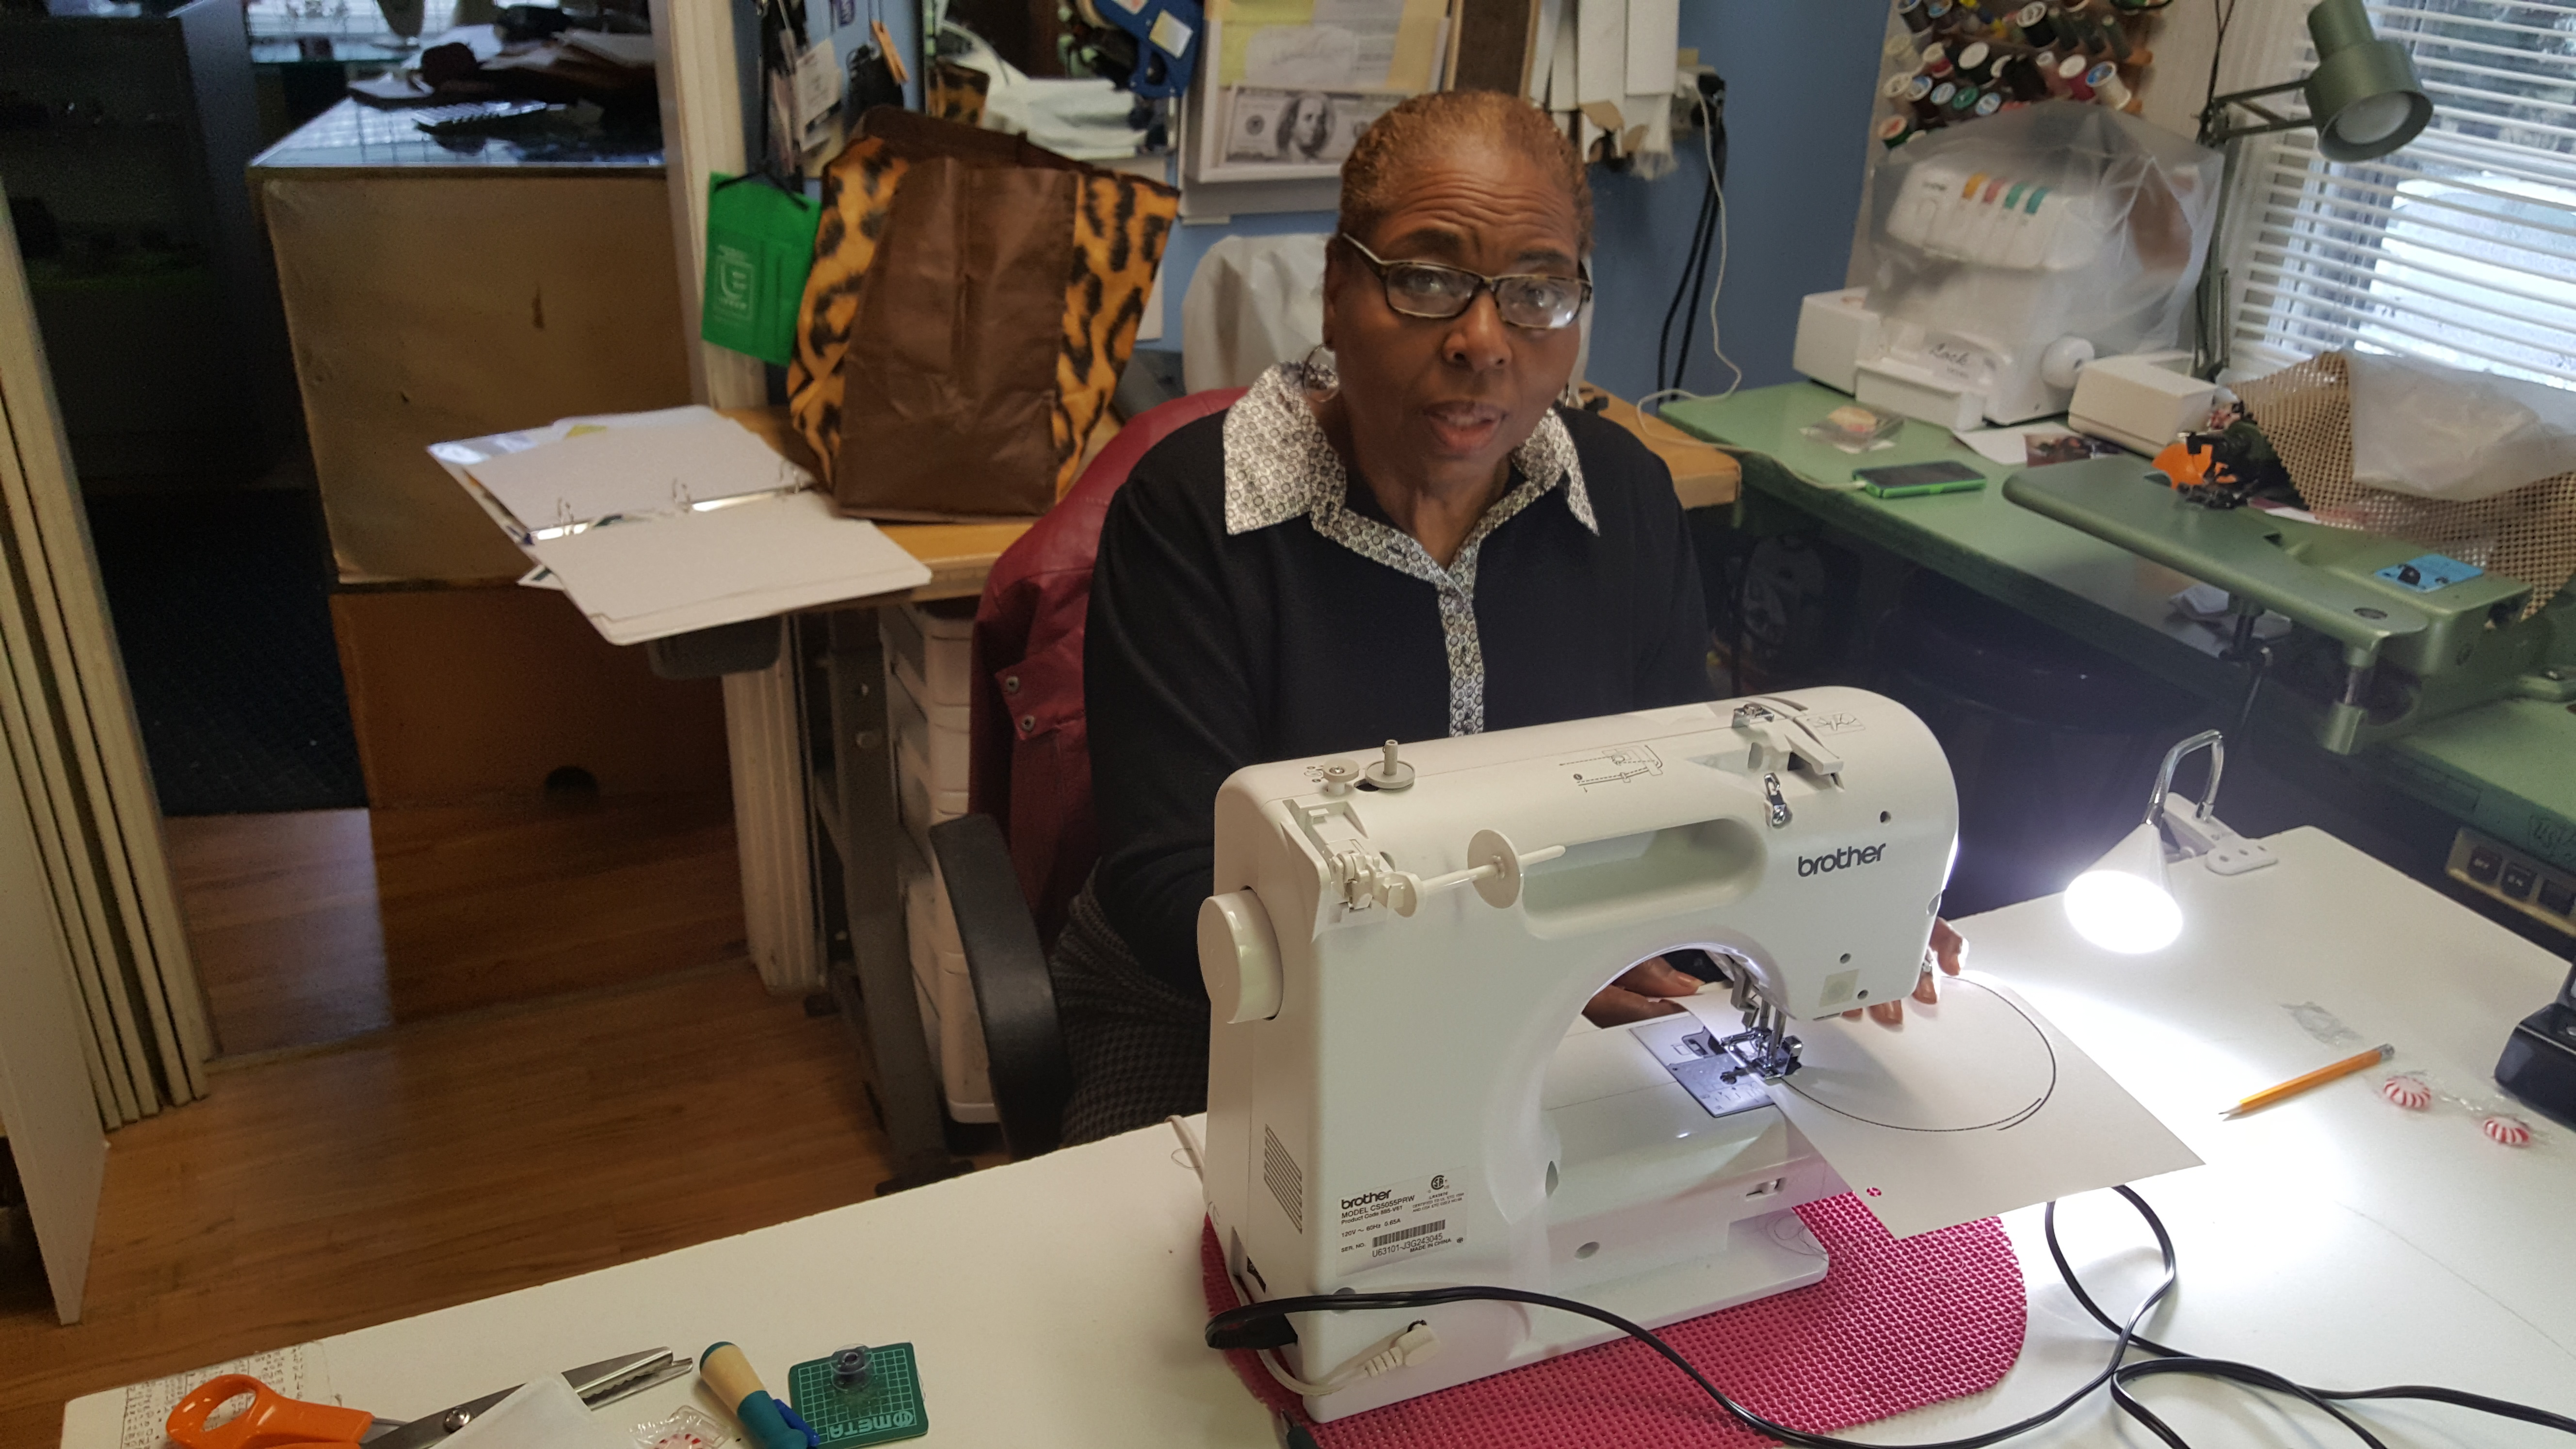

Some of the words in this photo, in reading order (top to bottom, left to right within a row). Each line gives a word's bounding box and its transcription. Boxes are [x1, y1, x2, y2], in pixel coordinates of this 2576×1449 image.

[1798, 843, 1886, 877] brother
[1341, 1189, 1392, 1209] brother
[1341, 1208, 1368, 1219] MODEL
[1370, 1195, 1415, 1211] CS5055PRW
[1341, 1215, 1363, 1224] Product
[1410, 1244, 1426, 1253] MADE
[1434, 1238, 1451, 1246] CHINA
